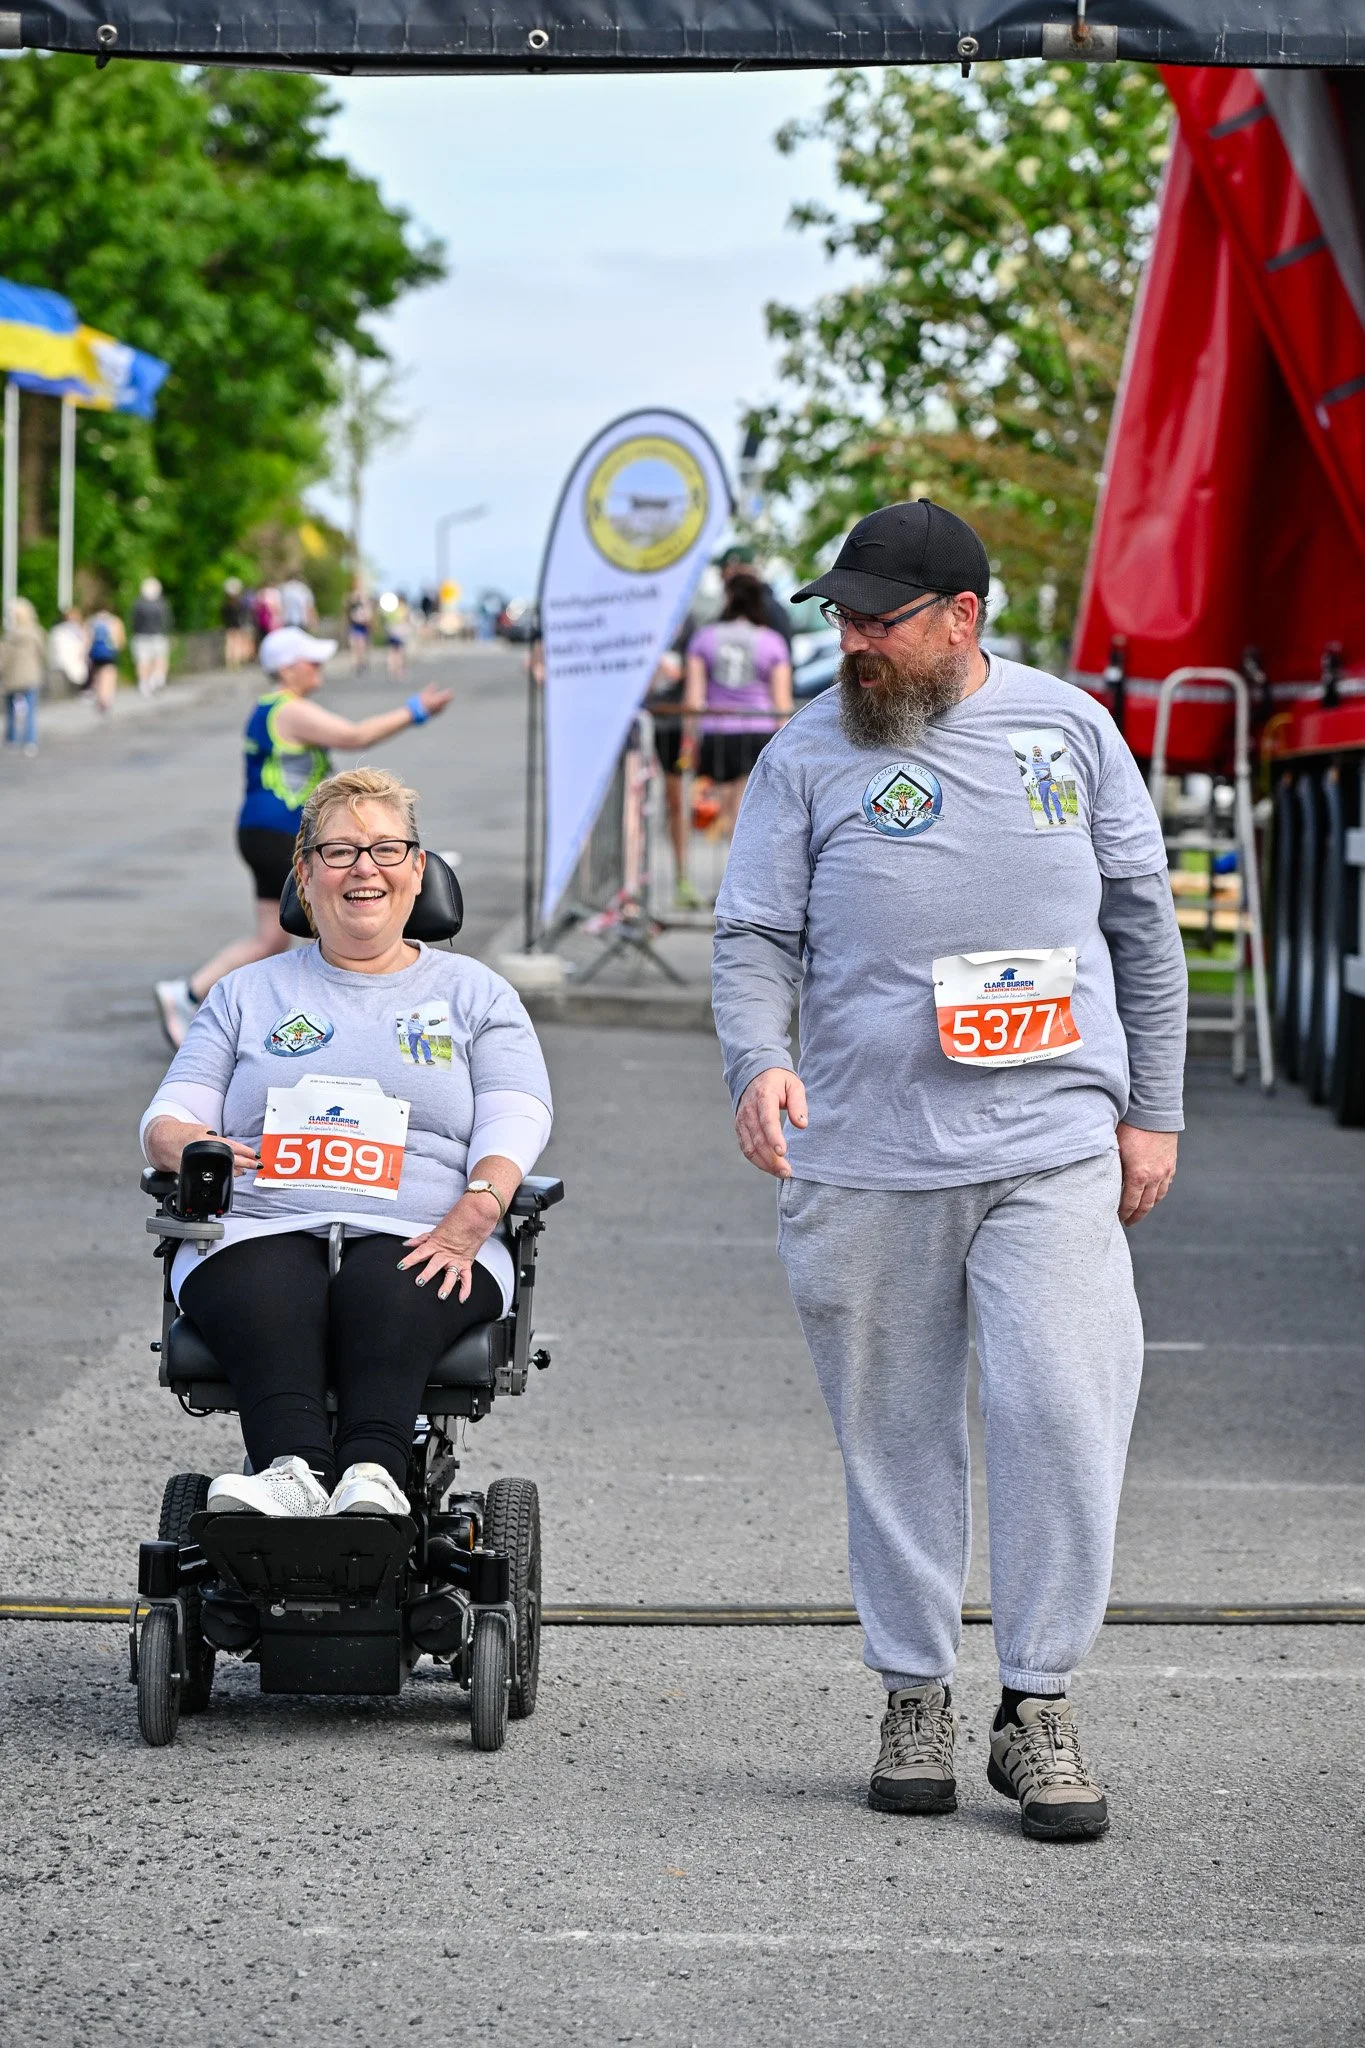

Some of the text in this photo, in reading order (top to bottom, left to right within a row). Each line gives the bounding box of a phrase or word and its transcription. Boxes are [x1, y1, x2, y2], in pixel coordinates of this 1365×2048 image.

[984, 980, 1034, 989] CLARE BURREN
[952, 1002, 1058, 1053] 5377
[308, 1115, 360, 1126] CLARE BURREN
[274, 1137, 385, 1182] 5199
